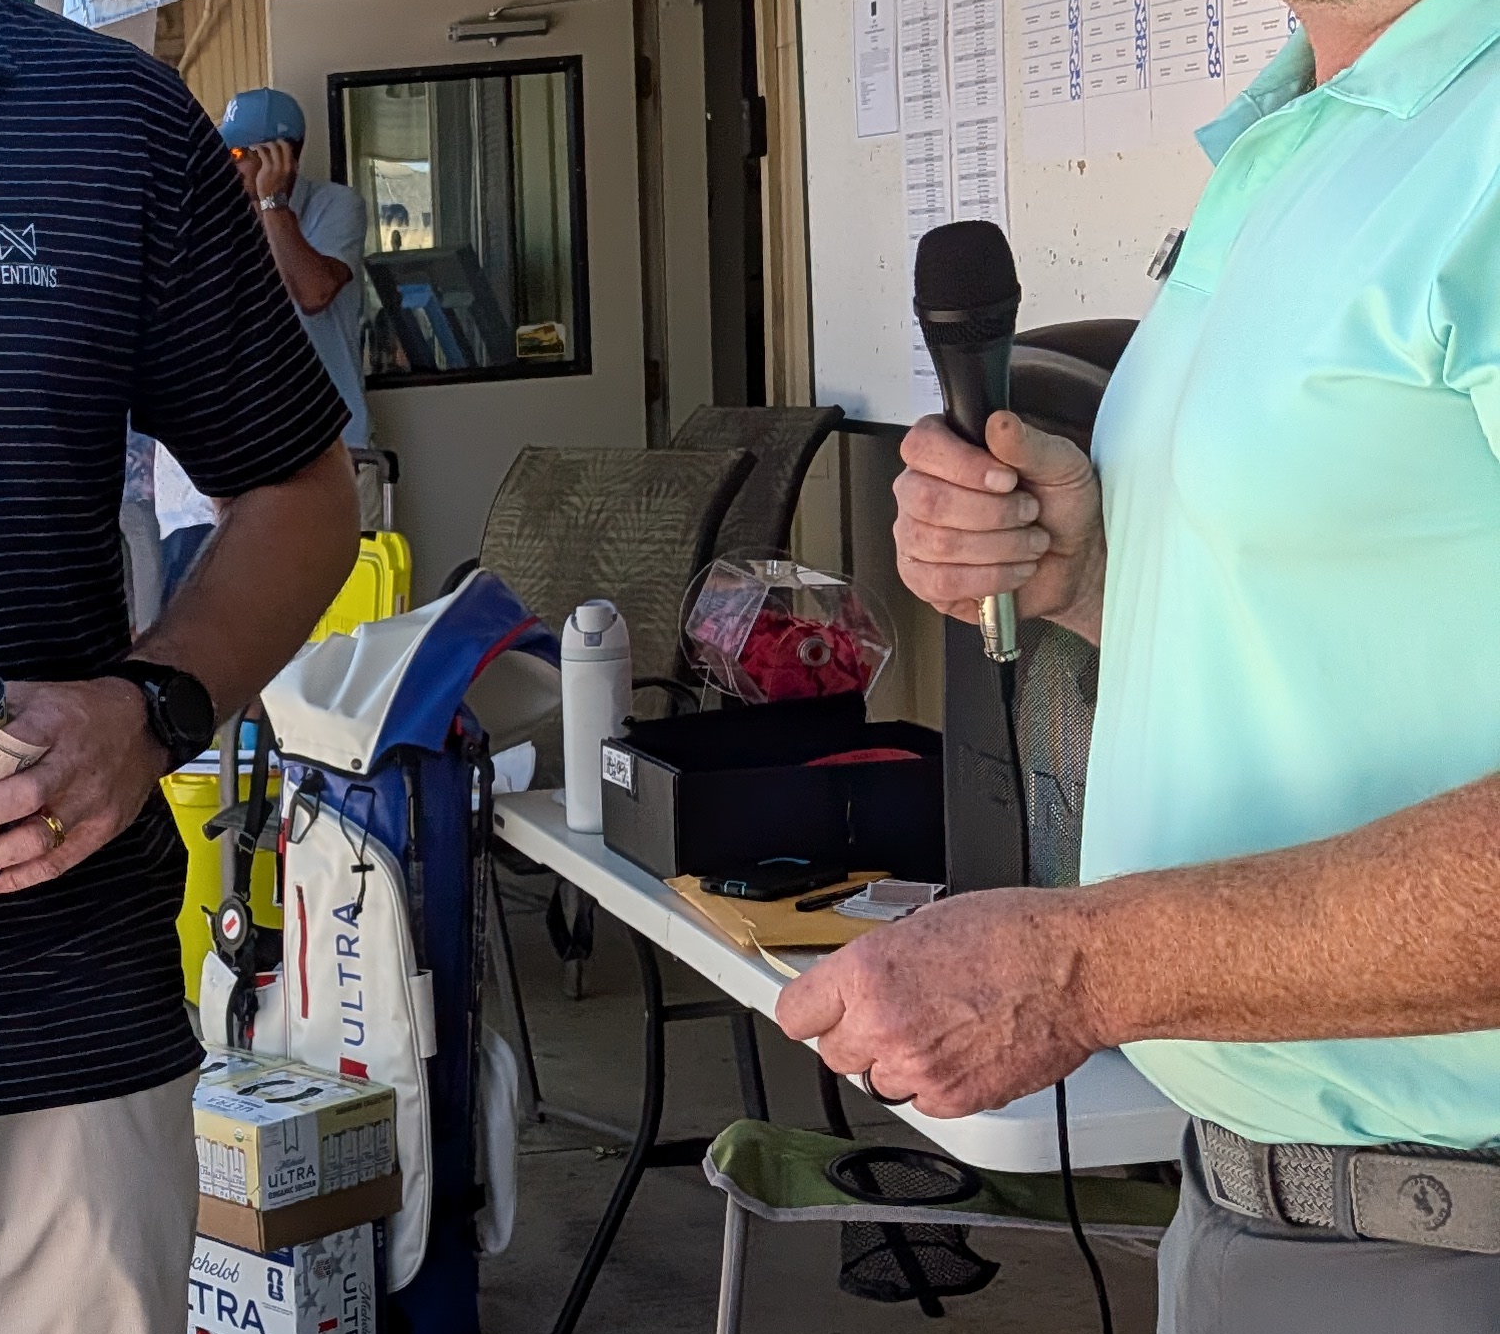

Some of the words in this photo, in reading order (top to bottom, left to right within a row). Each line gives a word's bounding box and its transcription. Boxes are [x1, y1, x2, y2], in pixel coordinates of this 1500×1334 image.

[332, 899, 366, 1047] ULTRA
[268, 1164, 316, 1188] ULTRA
[190, 1251, 241, 1284] chelob
